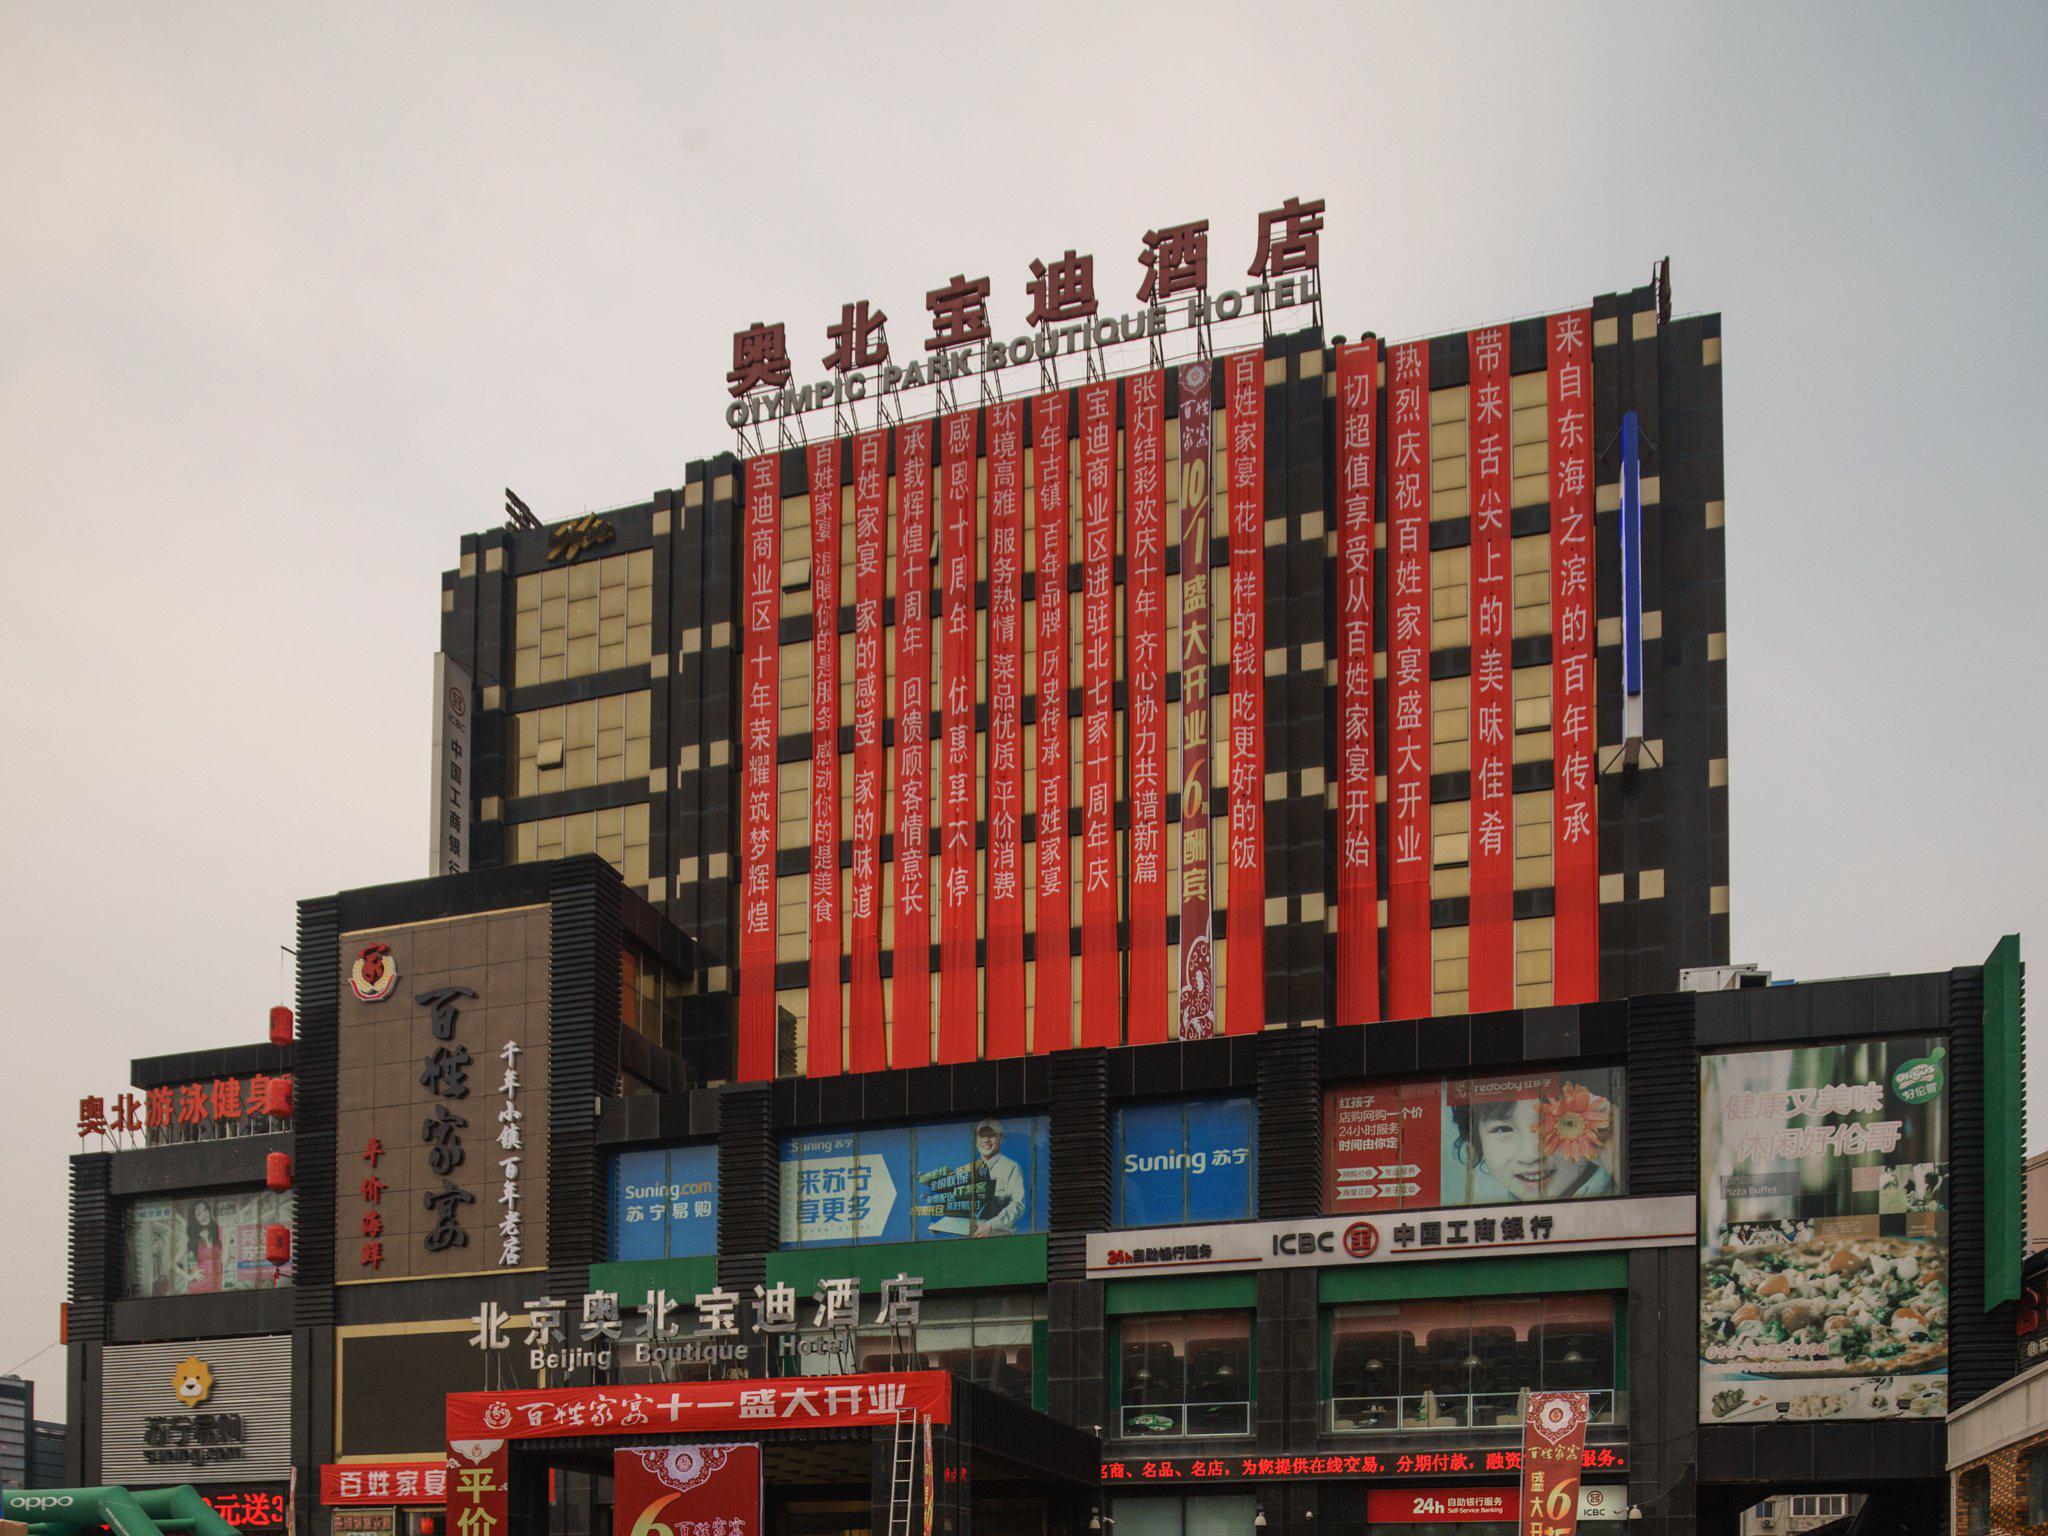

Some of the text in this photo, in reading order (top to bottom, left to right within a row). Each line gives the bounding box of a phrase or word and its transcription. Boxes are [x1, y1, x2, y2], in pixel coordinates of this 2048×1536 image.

[727, 197, 1325, 397] 奥北宝迪酒店
[883, 348, 973, 393] PARK
[986, 305, 1167, 371] BOUTIQUE
[1188, 274, 1321, 328] HOTEL
[948, 414, 971, 642] 感恩十周年
[1232, 350, 1258, 870] 百姓家宴 花一样的钱 吃更好的饭
[1344, 345, 1370, 868] 一切超值享受从百姓家宴开始
[1395, 344, 1422, 863] 热烈庆祝百姓家宴盛大开业
[1476, 329, 1505, 857] 带来舌尖上的美味佳肴
[1555, 315, 1590, 844] 来自东海之滨的百年传承
[993, 401, 1016, 900] 环境高雅 服务热情 菜品优质 平价消费
[1039, 395, 1062, 898] 千年古镇 百年品牌 历史传承 百姓家宴
[1086, 387, 1111, 893] 宝迪商业区进驻北七家十周年庆
[1133, 374, 1158, 885] 张灯结彩欢庆十年 齐心协力共谱新篇
[1183, 575, 1208, 751] 盛大开业
[748, 457, 774, 934] 宝迪商业区 十年荣耀筑梦辉煌
[852, 433, 882, 920] 百姓家宴 家的感受 家的味道
[901, 425, 925, 916] 承载辉煌十周年 回馈顾客情意长
[1183, 827, 1207, 903] 酬宾
[77, 1073, 293, 1137] 奥北游泳健身
[1339, 1122, 1400, 1137] 24小时服务
[1725, 1081, 1884, 1121] 健康又美味
[791, 1139, 832, 1153] Suning
[1125, 1147, 1250, 1174] Suning 苏宁
[1339, 1137, 1398, 1152] 时间由你定
[1737, 1121, 1903, 1163] 休闲好伦哥
[361, 1137, 388, 1270] 平价海鲜
[625, 1180, 712, 1201] Suning.com
[626, 1200, 712, 1222] 苏宁易购
[797, 1166, 872, 1196] 来苏宁
[797, 1195, 872, 1224] 享更多
[1272, 1215, 1554, 1256] ICBC 中国工商银行
[469, 1272, 924, 1350] 北京奥北宝迪酒店
[530, 1334, 849, 1371] Beijing Boutique Hotel
[656, 1384, 907, 1423] 十一盛大开业
[10, 1496, 73, 1510] oppo
[340, 1469, 447, 1498] 百姓家宴
[457, 1468, 498, 1536] 平价
[1413, 1497, 1502, 1514] 24h 自助银行服务
[1584, 1508, 1605, 1516] ICBC
